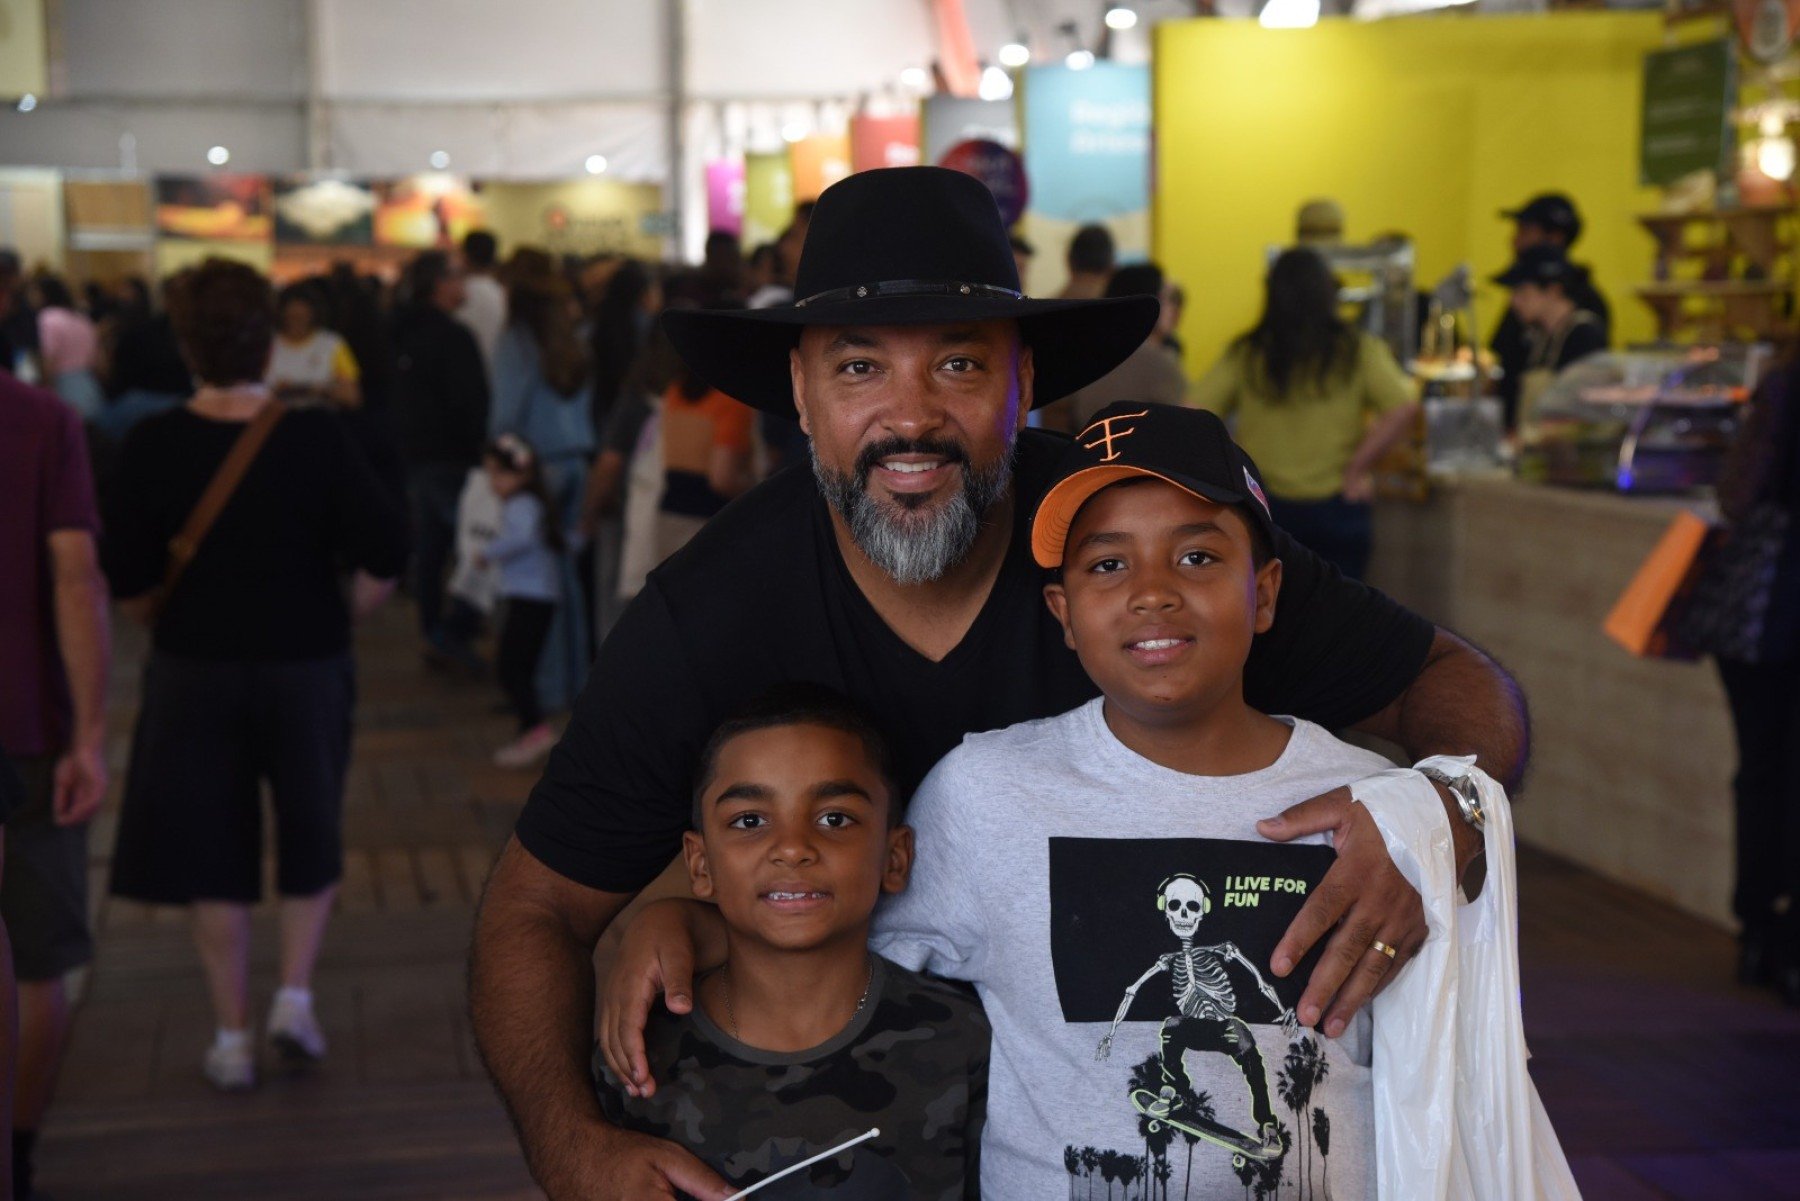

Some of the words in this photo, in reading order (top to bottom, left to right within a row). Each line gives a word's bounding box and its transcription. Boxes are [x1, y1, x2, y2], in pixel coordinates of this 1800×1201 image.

[1225, 876, 1232, 890] I
[1234, 876, 1271, 891] LIVE
[1273, 877, 1307, 894] FOR
[1223, 892, 1260, 907] FUN
